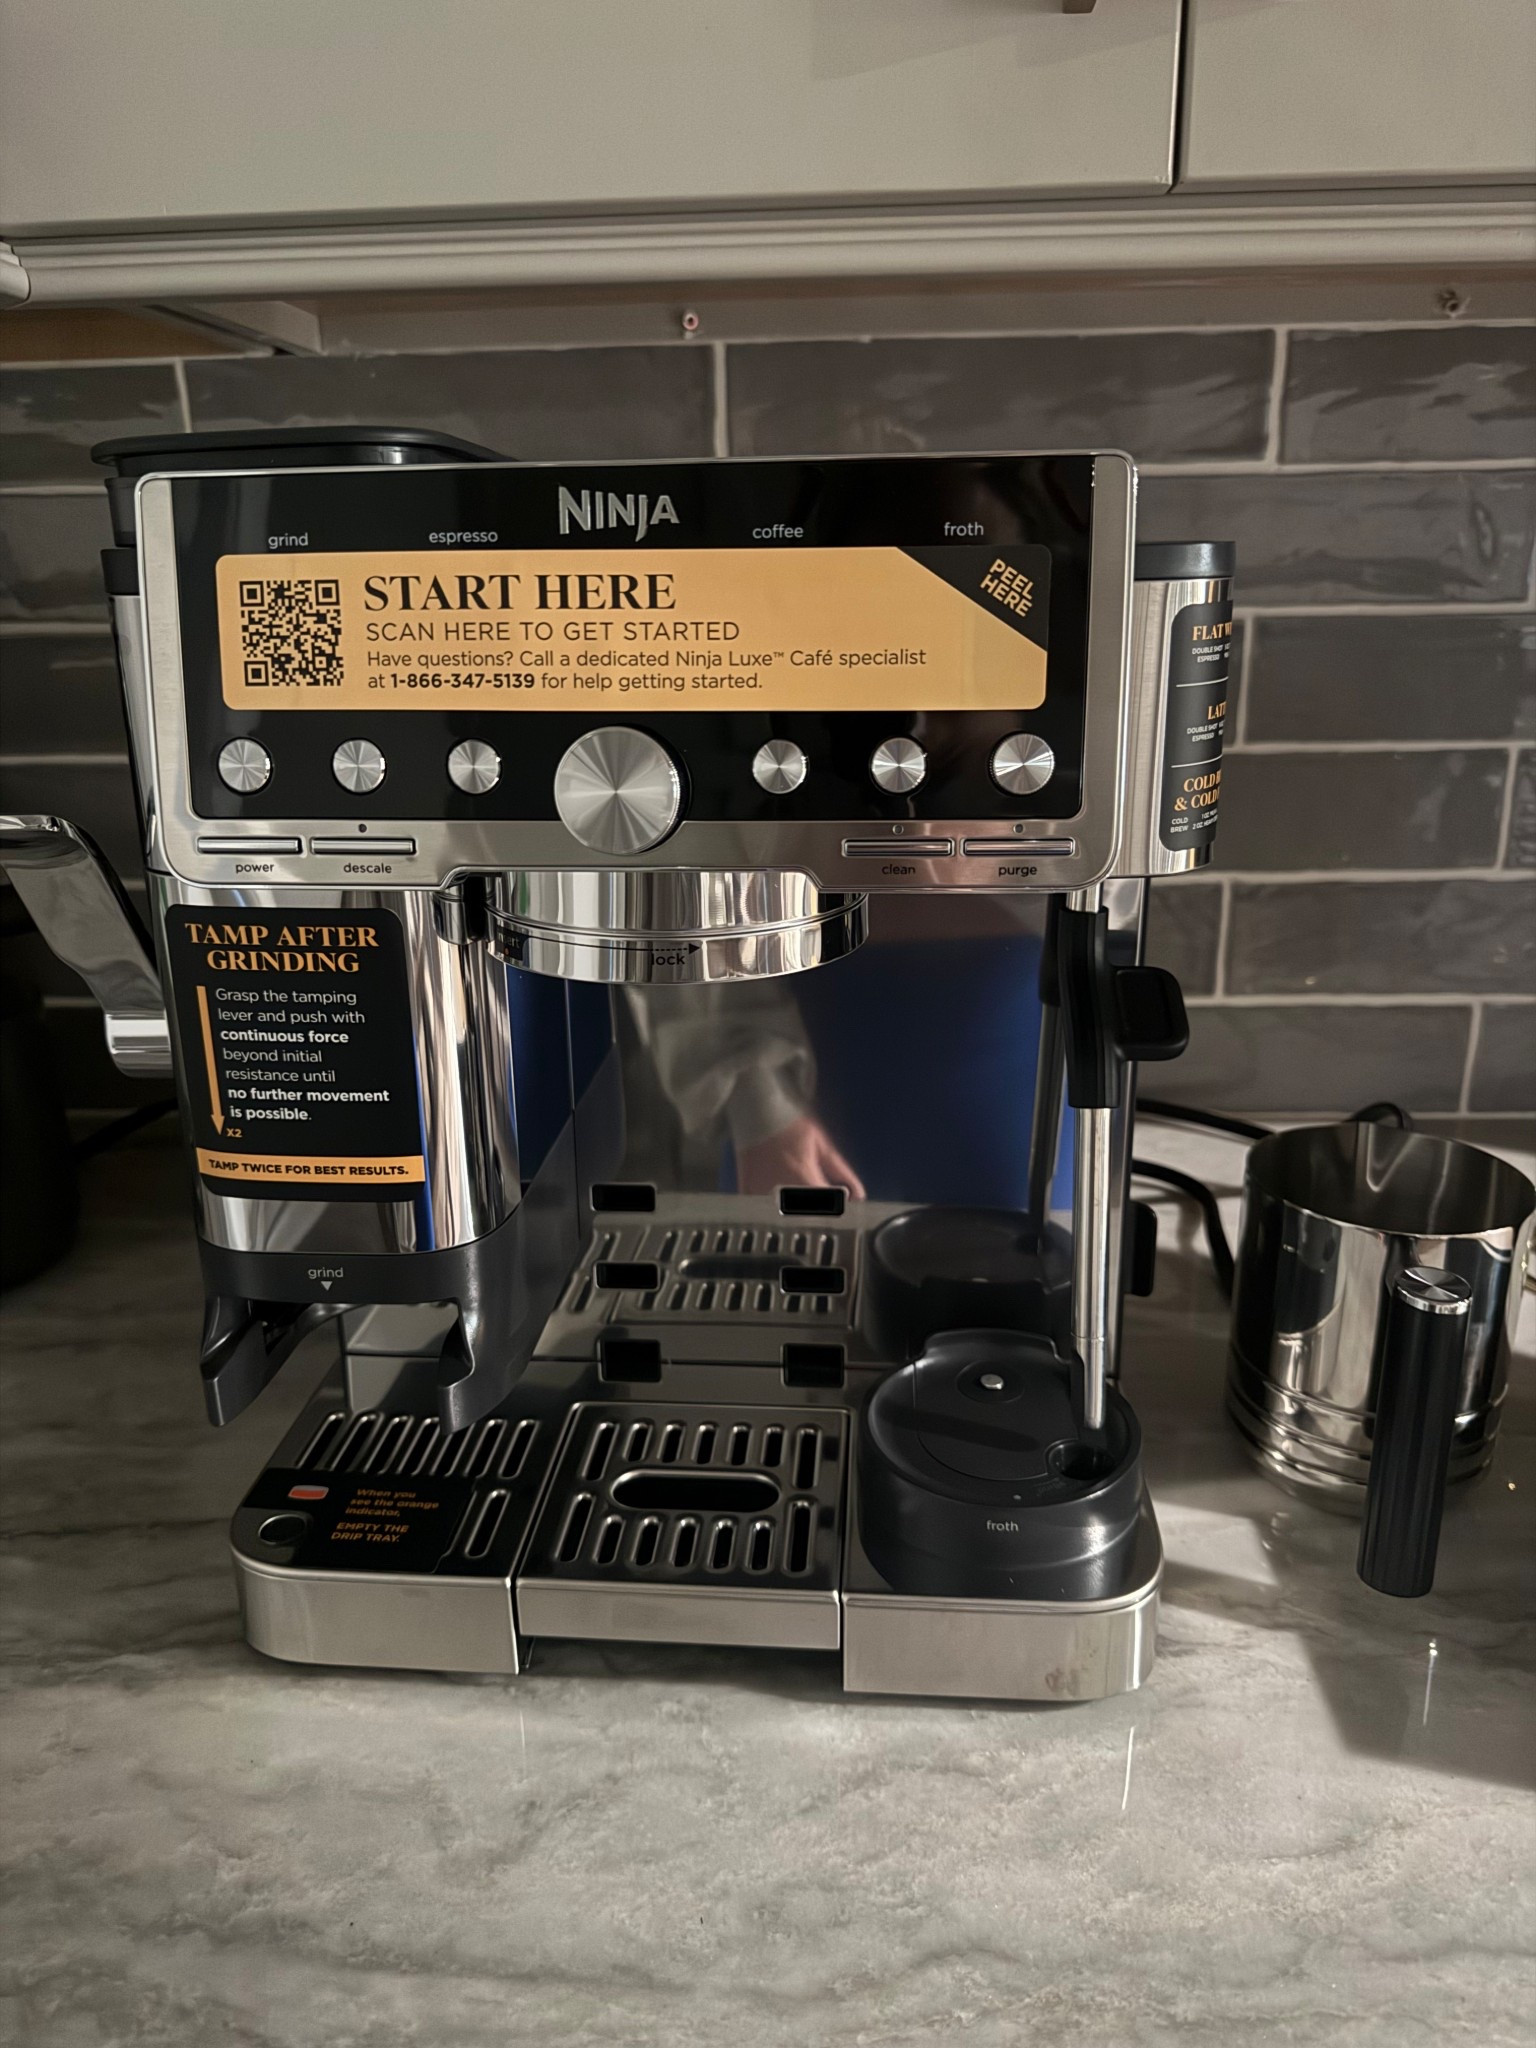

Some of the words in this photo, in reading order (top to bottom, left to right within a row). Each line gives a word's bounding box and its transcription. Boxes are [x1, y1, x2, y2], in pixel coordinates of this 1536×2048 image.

[558, 486, 680, 541] NINJA
[752, 523, 804, 540] coffee
[943, 521, 984, 537] froth
[268, 532, 308, 548] grind
[429, 529, 498, 546] espresso
[989, 558, 1035, 601] PEEL
[364, 574, 521, 612] START
[534, 573, 677, 612] HERE
[979, 574, 1033, 617] HERE
[366, 621, 435, 642] SCAN
[445, 621, 511, 642] HERE
[519, 621, 554, 642] TO
[563, 621, 614, 642] GET
[623, 621, 740, 642] STARTED
[1192, 623, 1224, 641] FLAT
[1192, 646, 1214, 655] DOUBLE
[367, 651, 412, 667] Have
[417, 650, 514, 671] questions?
[519, 650, 556, 667] Call
[560, 655, 571, 667] a
[576, 649, 669, 667] dedicated
[676, 649, 722, 670] Ninja
[790, 648, 833, 666] Café
[839, 648, 927, 670] specialist
[367, 675, 386, 689] at
[390, 673, 535, 689] 1-866-347-5139
[541, 673, 568, 689] for
[573, 673, 613, 692] help
[618, 673, 684, 692] getting
[691, 673, 763, 689] started.
[1187, 725, 1208, 734] DOUBLE
[1183, 773, 1216, 792] COLD
[1174, 797, 1188, 811] &
[1191, 789, 1217, 809] COLD
[1171, 816, 1188, 825] COLD
[1170, 825, 1189, 834] BREW
[235, 863, 274, 875] power
[343, 861, 392, 875] descale
[882, 864, 915, 875] clean
[998, 866, 1037, 877] purge
[185, 922, 269, 946] TAMP
[277, 925, 380, 948] AFTER
[206, 950, 360, 973] GRINDING
[651, 952, 685, 968] lock
[215, 987, 260, 1004] Grasp
[263, 989, 288, 1003] the
[292, 990, 357, 1006] tamping
[218, 1008, 254, 1022] lever
[257, 1009, 286, 1023] and
[290, 1010, 328, 1025] push
[331, 1010, 366, 1024] with
[220, 1029, 305, 1043] continuous
[308, 1030, 349, 1043] force
[222, 1047, 278, 1063] beyond
[282, 1049, 322, 1063] initial
[225, 1067, 299, 1082] resistance
[303, 1069, 336, 1083] until
[228, 1089, 247, 1099] no
[250, 1087, 303, 1101] further
[306, 1089, 390, 1102] movement
[230, 1105, 242, 1118] is
[246, 1106, 312, 1121] possible.
[208, 1159, 240, 1171] TAMP
[241, 1162, 282, 1174] TWICE
[285, 1164, 311, 1175] FOR
[314, 1165, 346, 1176] BEST
[349, 1165, 409, 1176] RESULTS.
[308, 1267, 343, 1279] grind
[356, 1488, 391, 1498] When
[393, 1491, 416, 1500] you
[345, 1507, 400, 1517] indicator,
[350, 1498, 372, 1506] see
[374, 1498, 394, 1507] the
[396, 1500, 440, 1511] orange
[336, 1521, 381, 1532] EMPTY
[383, 1523, 411, 1533] THE
[986, 1520, 1019, 1532] froth
[330, 1531, 364, 1542] DRIP
[365, 1533, 400, 1543] TRAY.
